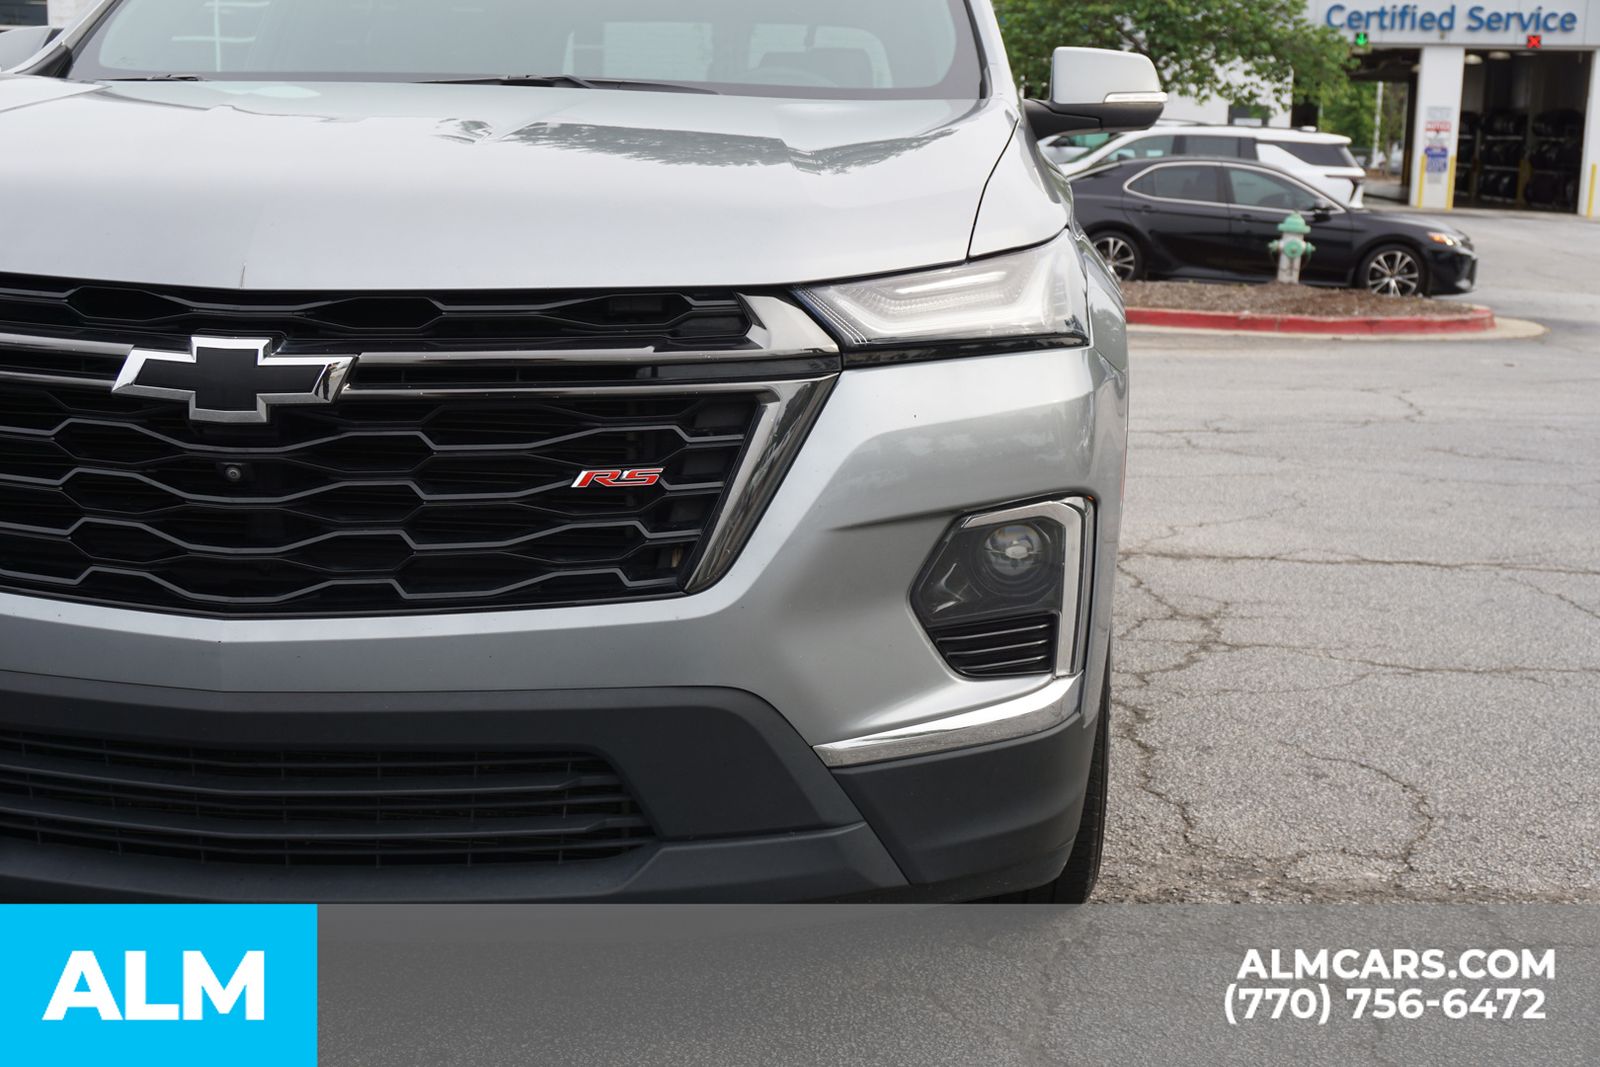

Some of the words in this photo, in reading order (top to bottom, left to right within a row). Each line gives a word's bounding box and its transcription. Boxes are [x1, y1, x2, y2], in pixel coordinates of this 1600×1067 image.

[1327, 5, 1455, 31] Certified
[1467, 5, 1577, 32] Service
[571, 468, 663, 488] RS
